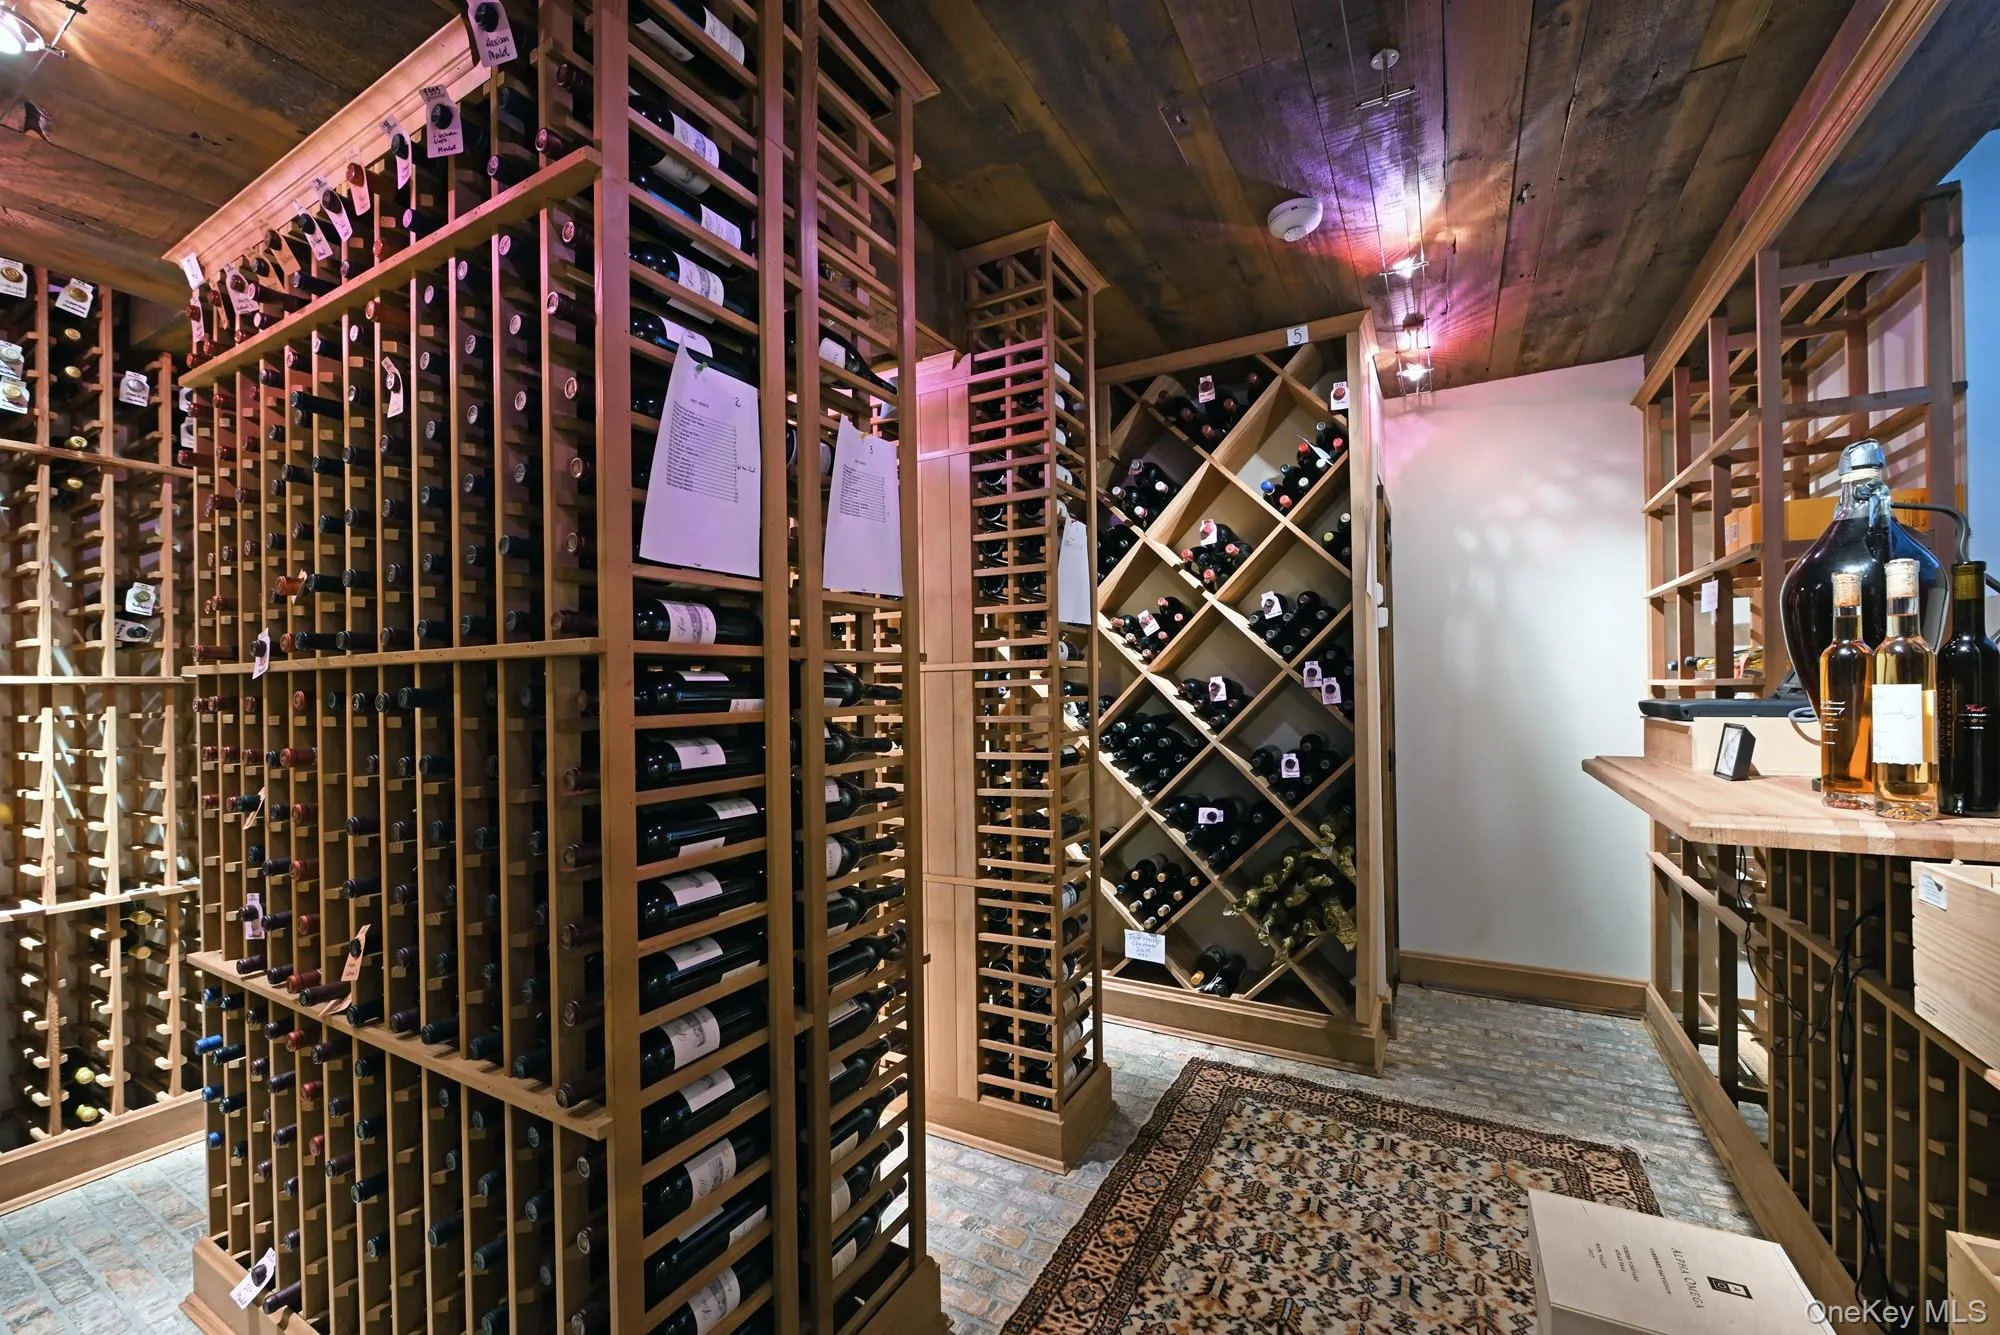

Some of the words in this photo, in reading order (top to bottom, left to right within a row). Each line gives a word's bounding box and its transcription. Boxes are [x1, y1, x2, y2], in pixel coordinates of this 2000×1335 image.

[1292, 327, 1302, 344] 5
[734, 396, 741, 408] 2
[869, 445, 874, 455] 3
[1671, 1248, 1689, 1274] ALPHA
[1684, 1277, 1704, 1308] OMEGA
